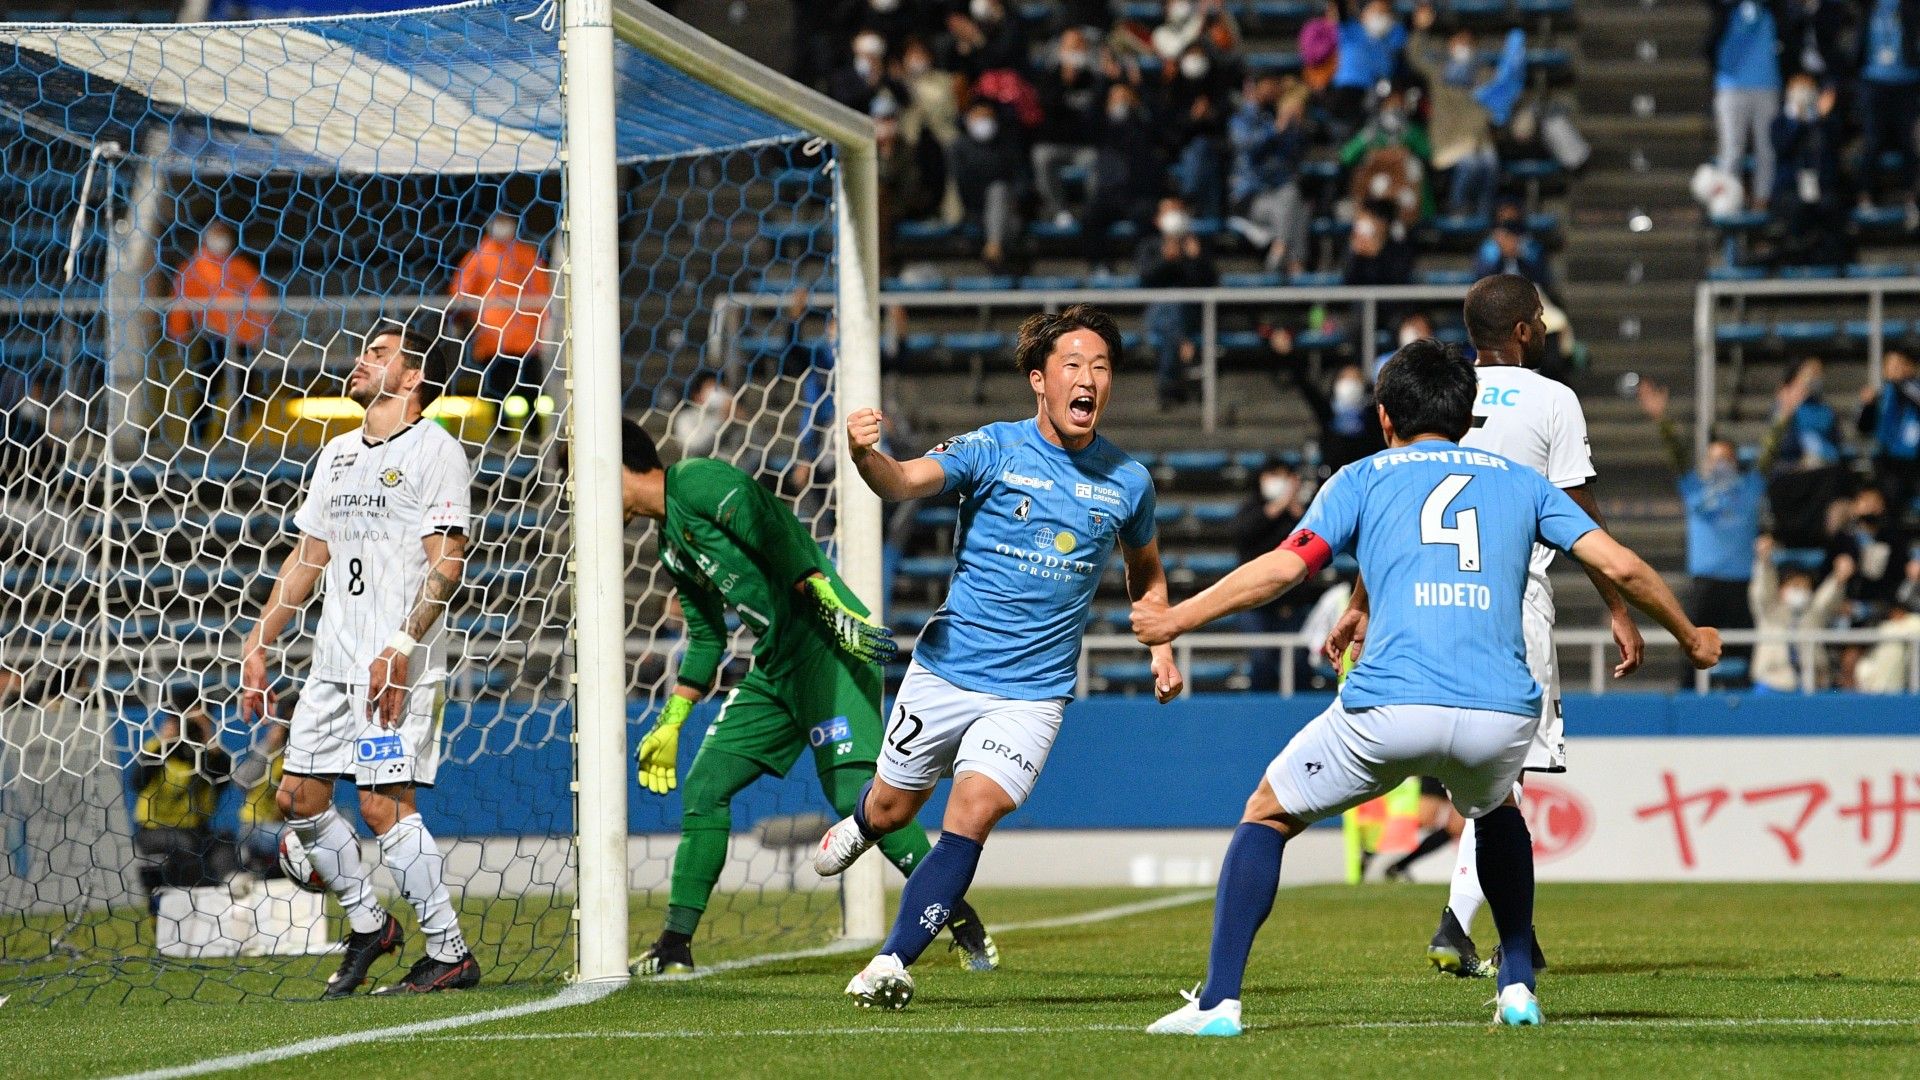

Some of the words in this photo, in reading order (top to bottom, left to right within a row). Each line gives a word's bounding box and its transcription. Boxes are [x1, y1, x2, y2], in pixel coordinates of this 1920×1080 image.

[1373, 450, 1509, 471] FRONTIER
[330, 494, 386, 508] HITACHI
[1092, 493, 1120, 506] CREATION
[1093, 485, 1120, 498] FUDEAL
[1419, 473, 1481, 573] 4
[338, 530, 390, 543] LUMADA
[347, 557, 365, 596] 8
[1018, 563, 1072, 583] GROUP
[1414, 582, 1490, 611] HIDETO
[887, 704, 924, 757] 22
[1634, 770, 1920, 869] ヤマザ
[919, 915, 938, 936] YFC
